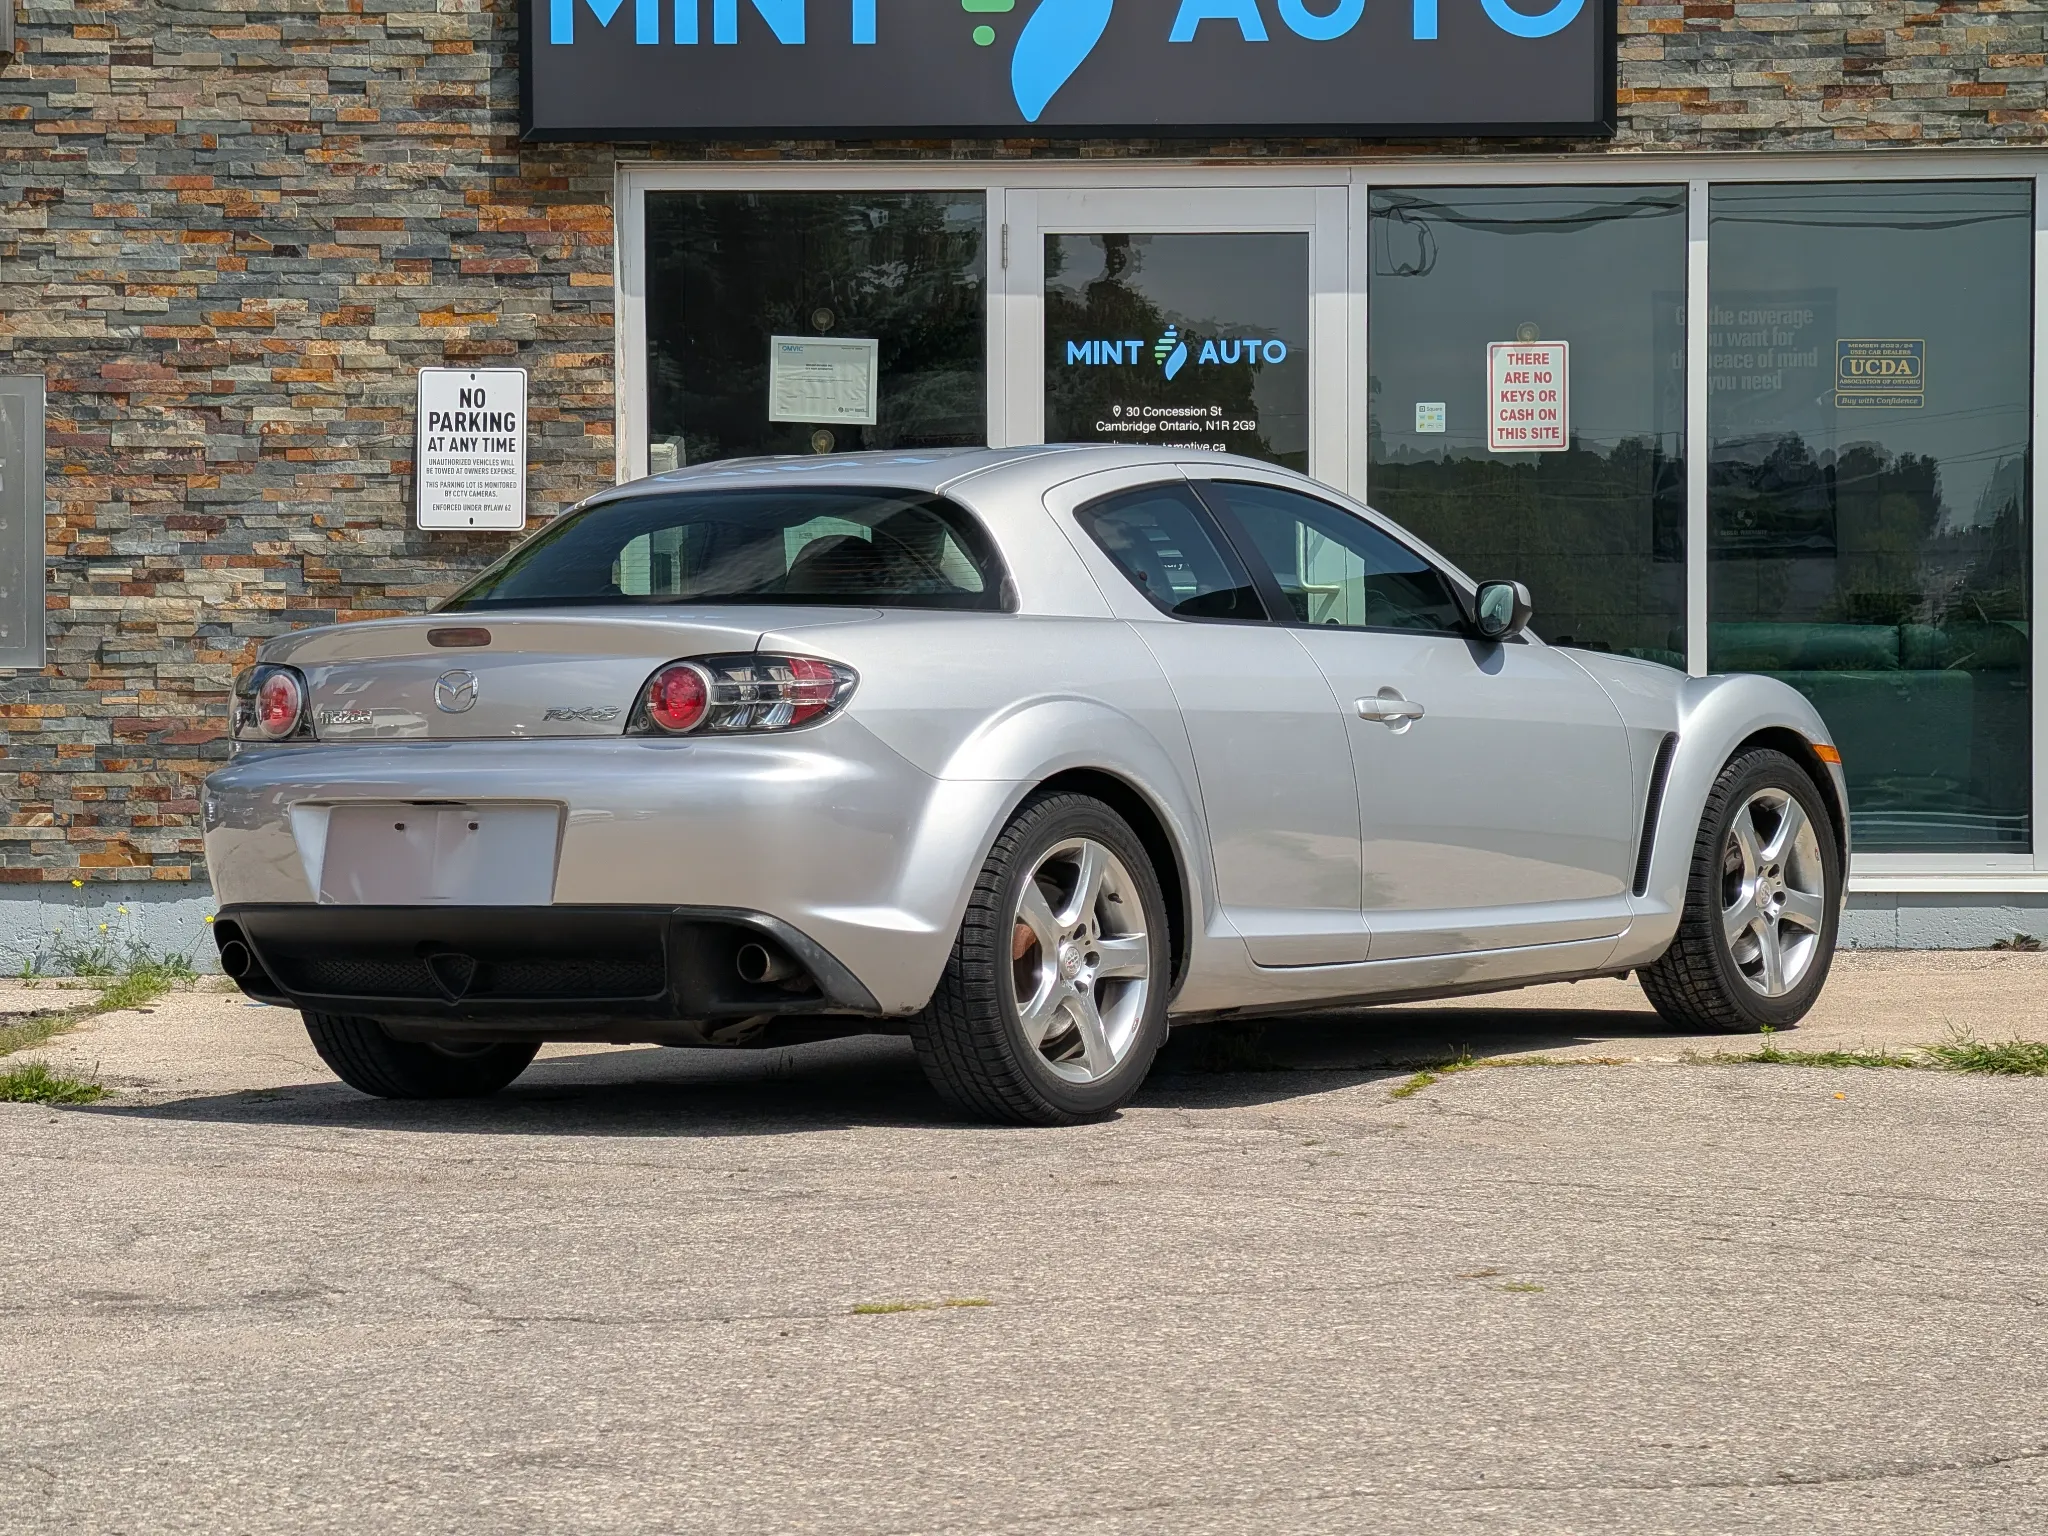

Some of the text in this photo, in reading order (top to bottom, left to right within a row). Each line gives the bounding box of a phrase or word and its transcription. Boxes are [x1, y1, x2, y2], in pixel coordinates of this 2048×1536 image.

[1738, 309, 1814, 329] coverage
[1726, 328, 1769, 347] want
[1772, 325, 1796, 346] for
[1067, 339, 1287, 365] MINT AUTO
[1757, 347, 1774, 368] of
[1777, 346, 1818, 367] mind
[1507, 353, 1550, 365] THERE
[1850, 359, 1912, 375] UCDA
[1504, 372, 1552, 384] ARE NO
[1741, 368, 1782, 390] need
[459, 388, 486, 408] NO
[1500, 390, 1557, 402] KEYS OR
[1841, 397, 1857, 405] Buy
[1876, 397, 1918, 405] Confidence
[1126, 405, 1222, 417] 30 Concession St
[1500, 409, 1557, 421] CASH ON
[428, 411, 516, 433] PARKING
[1096, 420, 1256, 433] Cambridge Ontario, N1R 2G9
[1497, 426, 1560, 439] THIS SITE
[427, 437, 516, 452] AT ANY TIME
[428, 458, 515, 466] UNAUTHORIZED VEHICLES WILL
[426, 467, 433, 475] BE
[434, 467, 455, 475] TOWED
[455, 467, 463, 475] AT
[464, 467, 489, 475] OWNERS
[484, 481, 517, 489] MONITORED
[468, 490, 498, 498] CAMERAS.
[432, 503, 461, 511] ENFORCED
